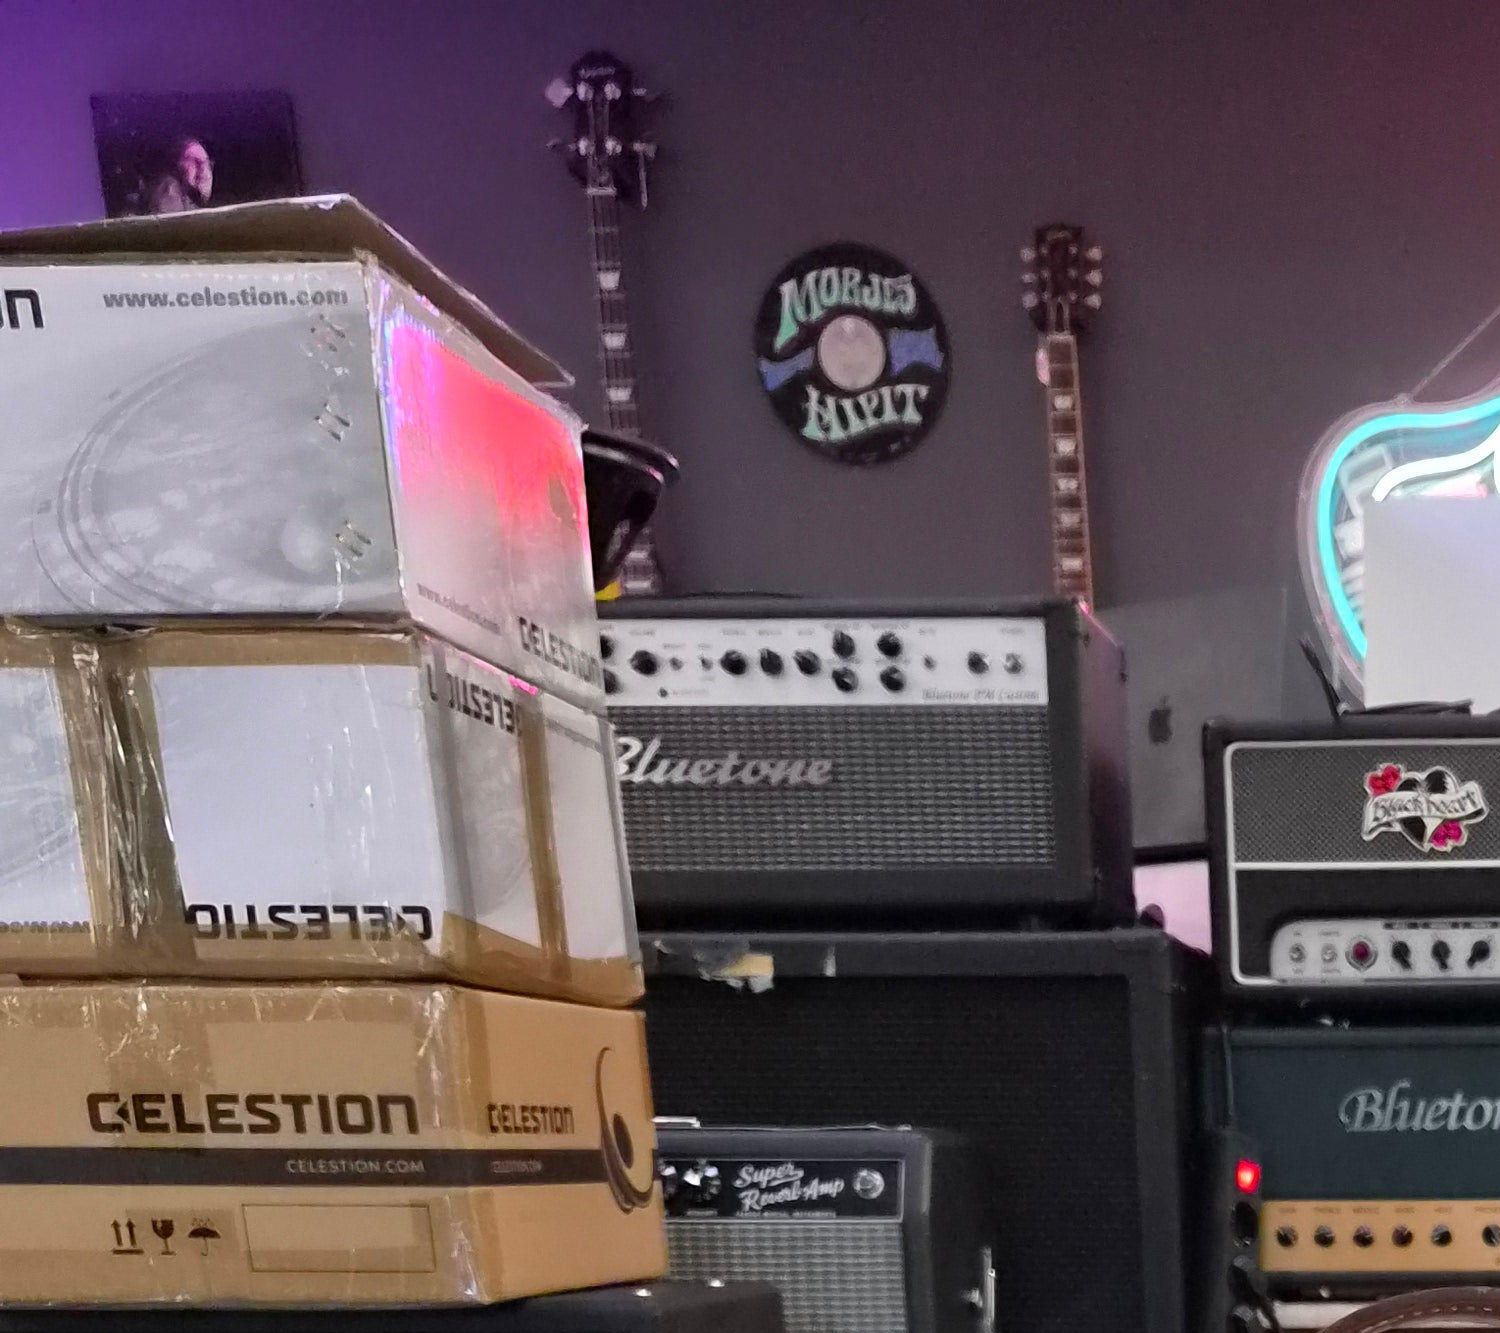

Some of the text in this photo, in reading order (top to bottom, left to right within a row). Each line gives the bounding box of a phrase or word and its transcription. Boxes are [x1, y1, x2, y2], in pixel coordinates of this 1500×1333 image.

[103, 286, 348, 308] www.celestion.com
[184, 903, 433, 941] CELESTIO
[86, 1092, 420, 1135] CELESTION
[487, 1102, 574, 1135] CELESTION
[732, 1162, 804, 1189] Super
